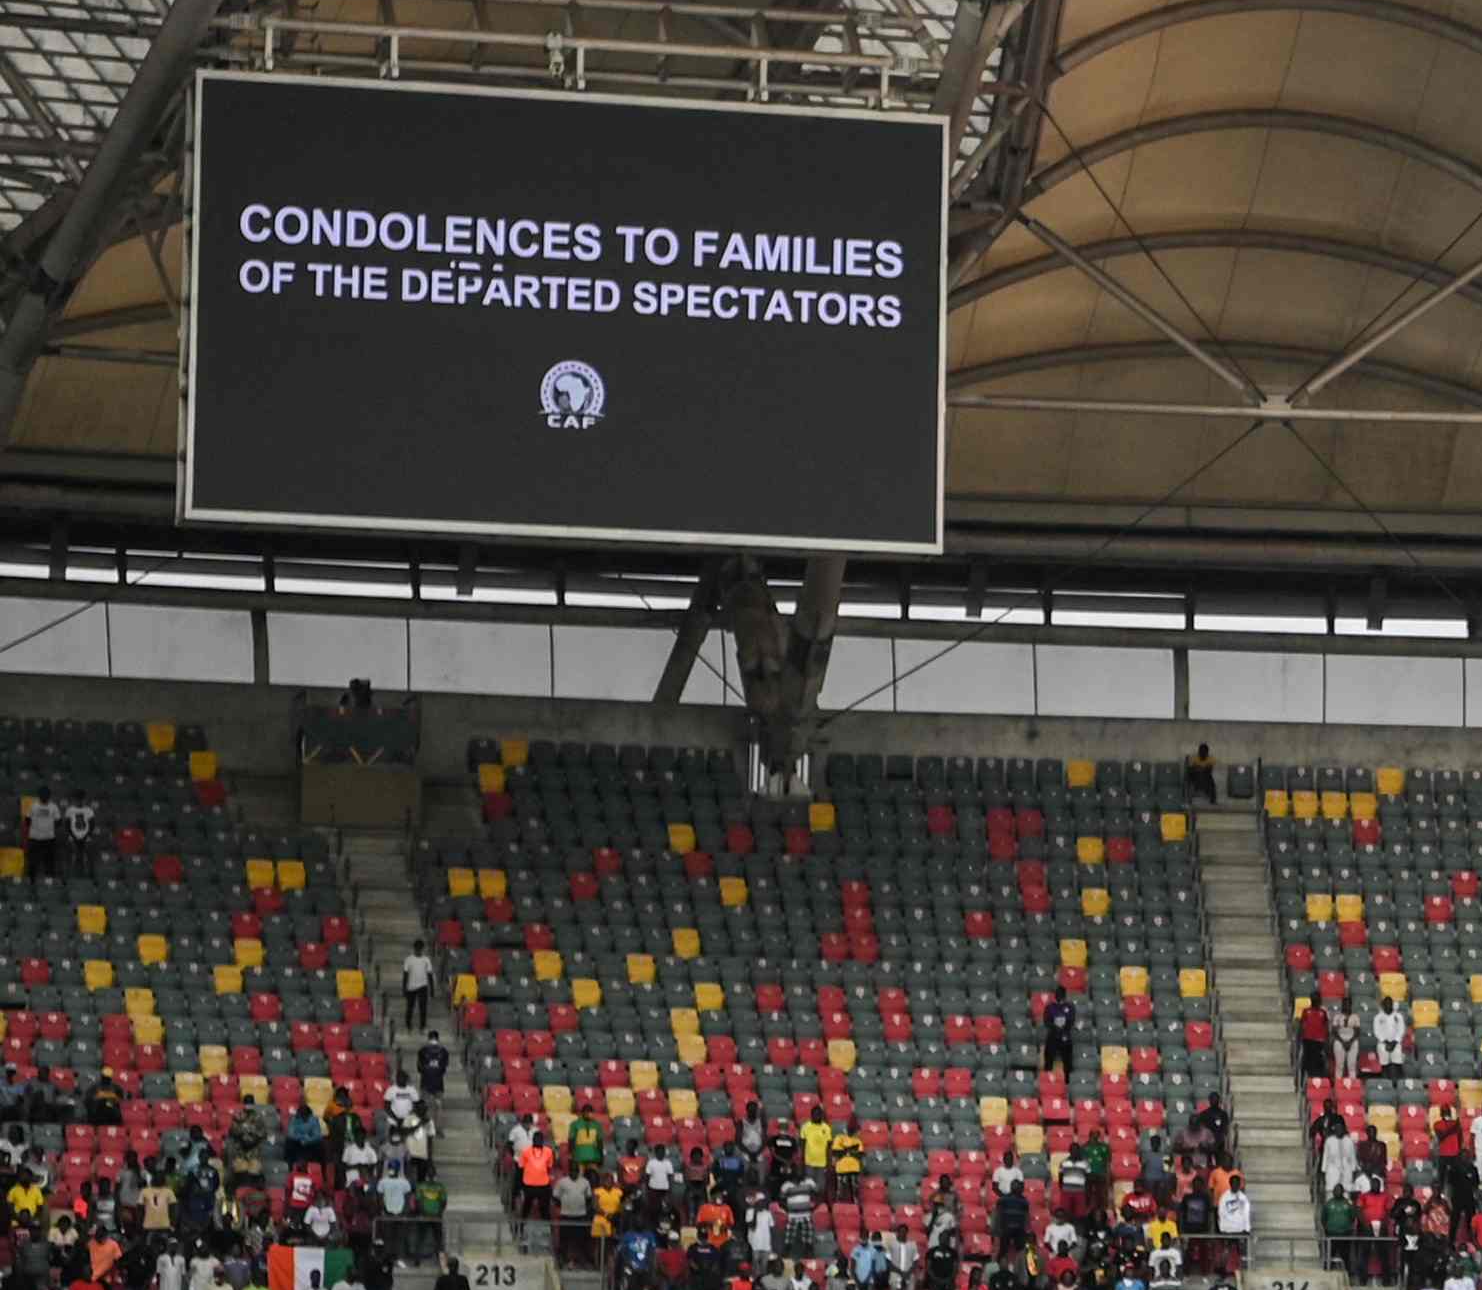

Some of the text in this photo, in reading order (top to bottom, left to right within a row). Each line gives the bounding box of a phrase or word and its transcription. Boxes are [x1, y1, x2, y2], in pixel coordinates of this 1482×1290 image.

[239, 203, 904, 279] CONDOLENCES TO FAMILIES
[239, 260, 903, 328] OF THE DEPARTED SPECTATORS
[547, 414, 596, 430] CAF
[476, 1265, 517, 1287] 213
